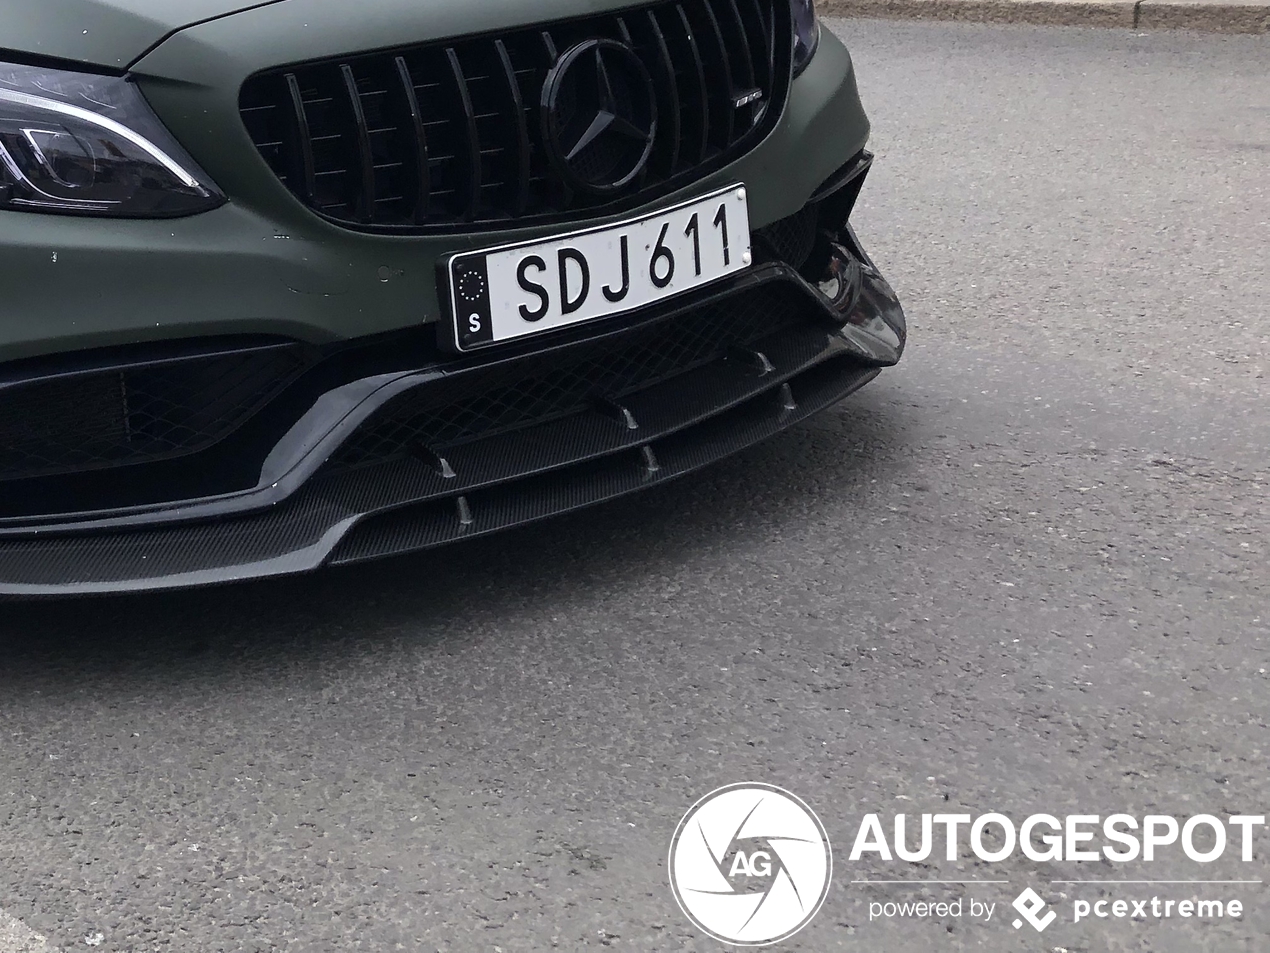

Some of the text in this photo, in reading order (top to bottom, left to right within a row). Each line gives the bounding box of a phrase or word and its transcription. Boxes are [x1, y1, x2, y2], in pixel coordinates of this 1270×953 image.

[516, 203, 731, 322] SDJ 611
[468, 312, 481, 333] S
